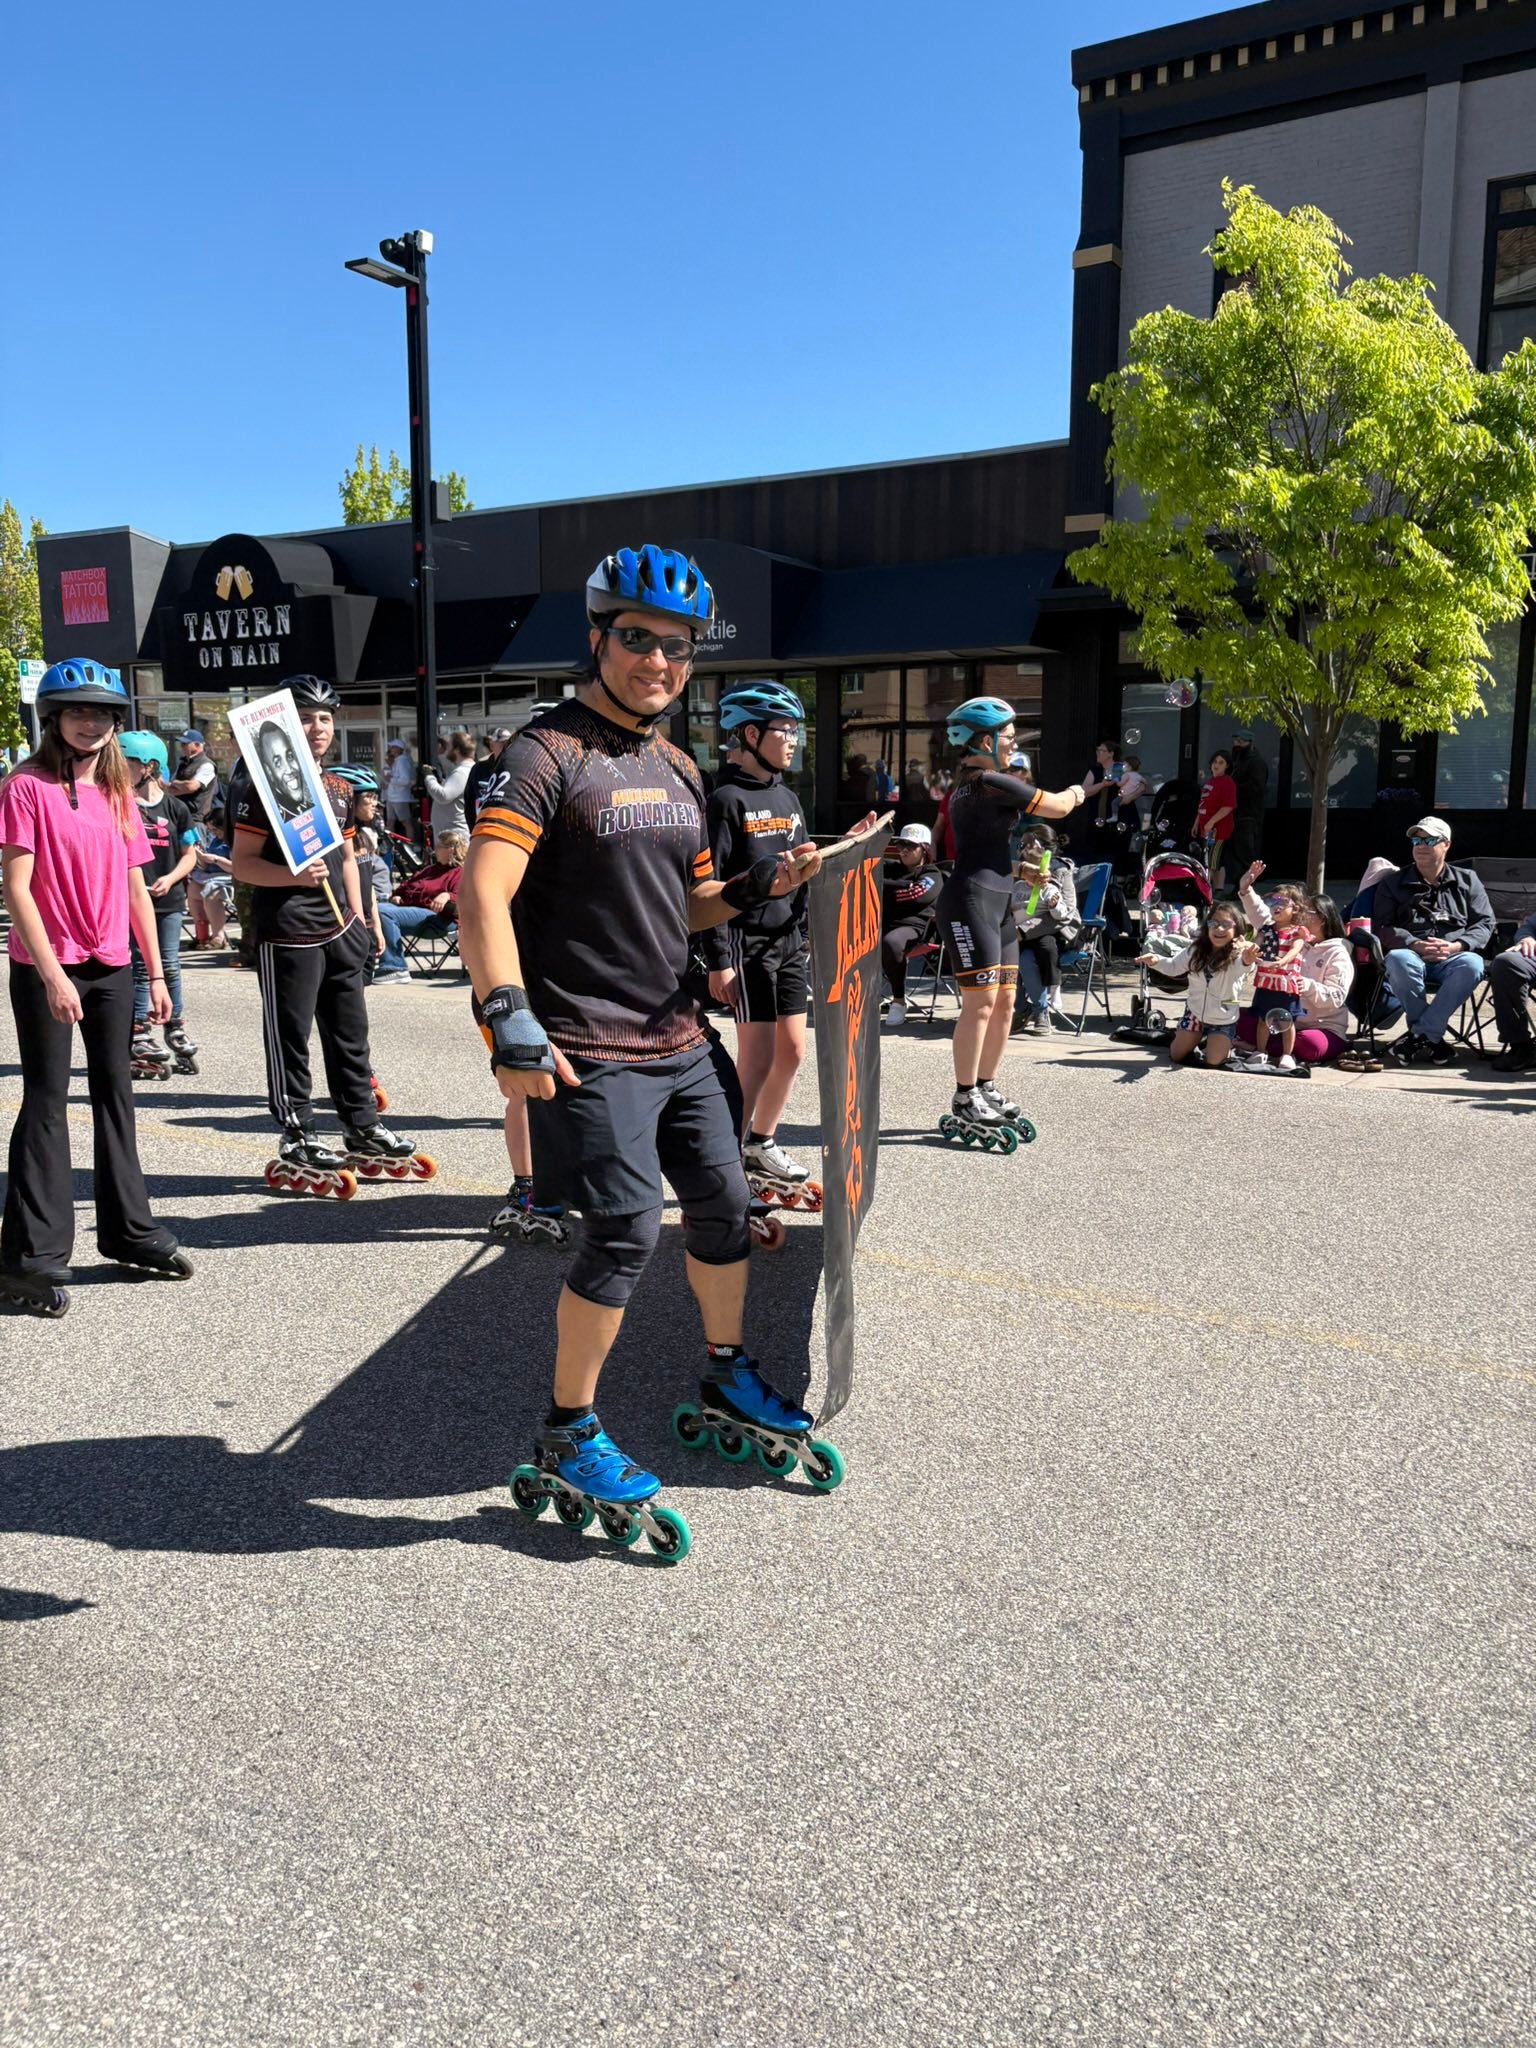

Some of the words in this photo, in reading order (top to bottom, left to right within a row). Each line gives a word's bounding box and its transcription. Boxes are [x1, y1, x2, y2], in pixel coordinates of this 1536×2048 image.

[61, 568, 106, 580] MATCHBOX
[63, 581, 106, 599] TATTOO
[183, 604, 291, 642] TAVERN
[199, 647, 222, 669] ON
[230, 642, 280, 667] MAIN
[249, 701, 286, 723] REMEMBER
[611, 787, 669, 808] MIDLAND
[745, 809, 772, 821] IDLAND
